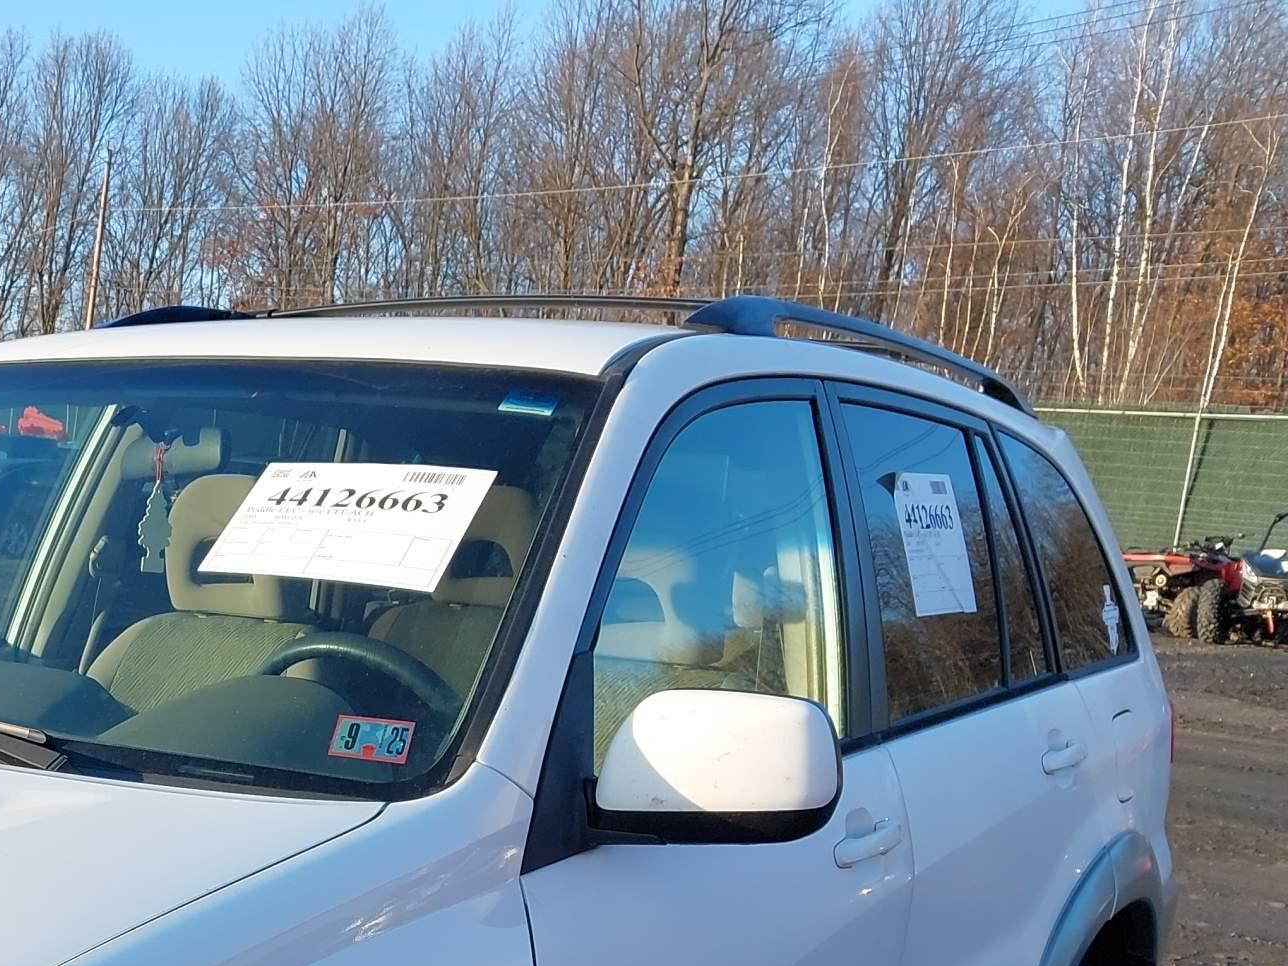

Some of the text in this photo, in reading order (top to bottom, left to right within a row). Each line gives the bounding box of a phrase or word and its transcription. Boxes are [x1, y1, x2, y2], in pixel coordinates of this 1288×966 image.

[267, 487, 449, 514] 44126663
[904, 503, 954, 530] 44126663
[386, 726, 410, 755] 25
